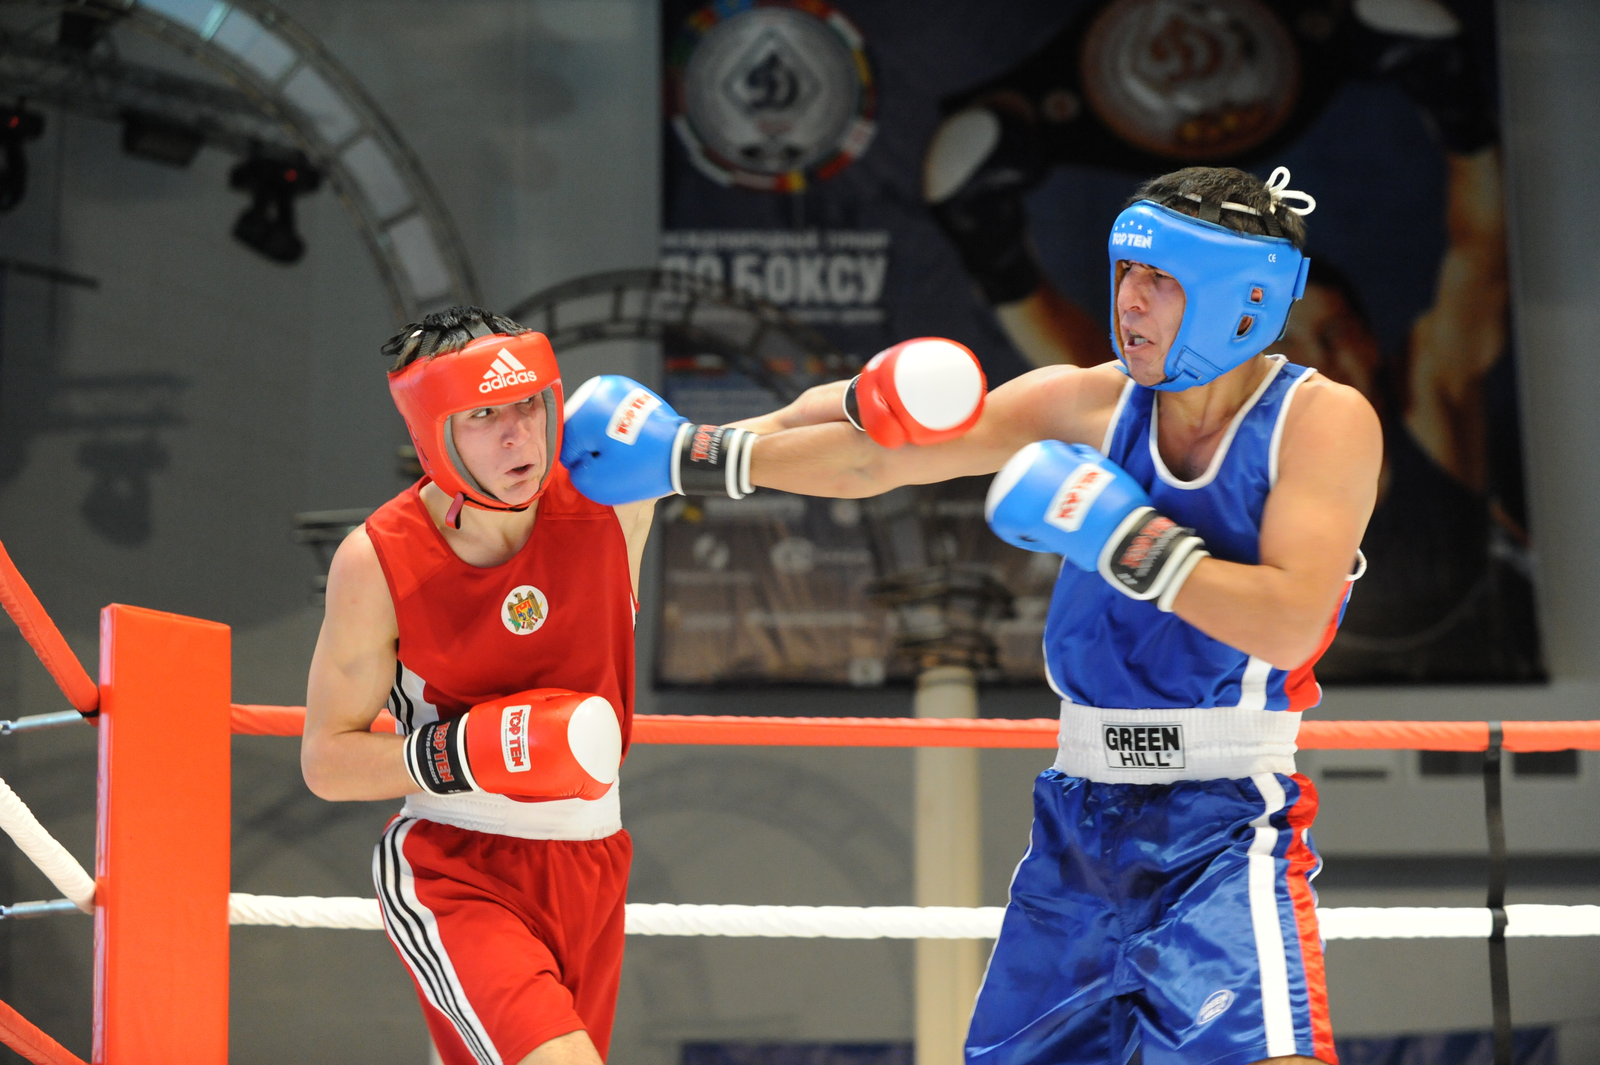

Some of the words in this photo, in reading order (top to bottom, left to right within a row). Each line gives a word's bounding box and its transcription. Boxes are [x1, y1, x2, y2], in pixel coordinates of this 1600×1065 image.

[1127, 233, 1153, 249] TEN
[731, 254, 887, 304] БОКСУ
[478, 370, 537, 394] adidas
[433, 721, 451, 751] TOP
[509, 709, 524, 736] TOP
[509, 736, 524, 767] TEN
[1105, 726, 1180, 751] GREEN
[434, 750, 455, 783] TEN
